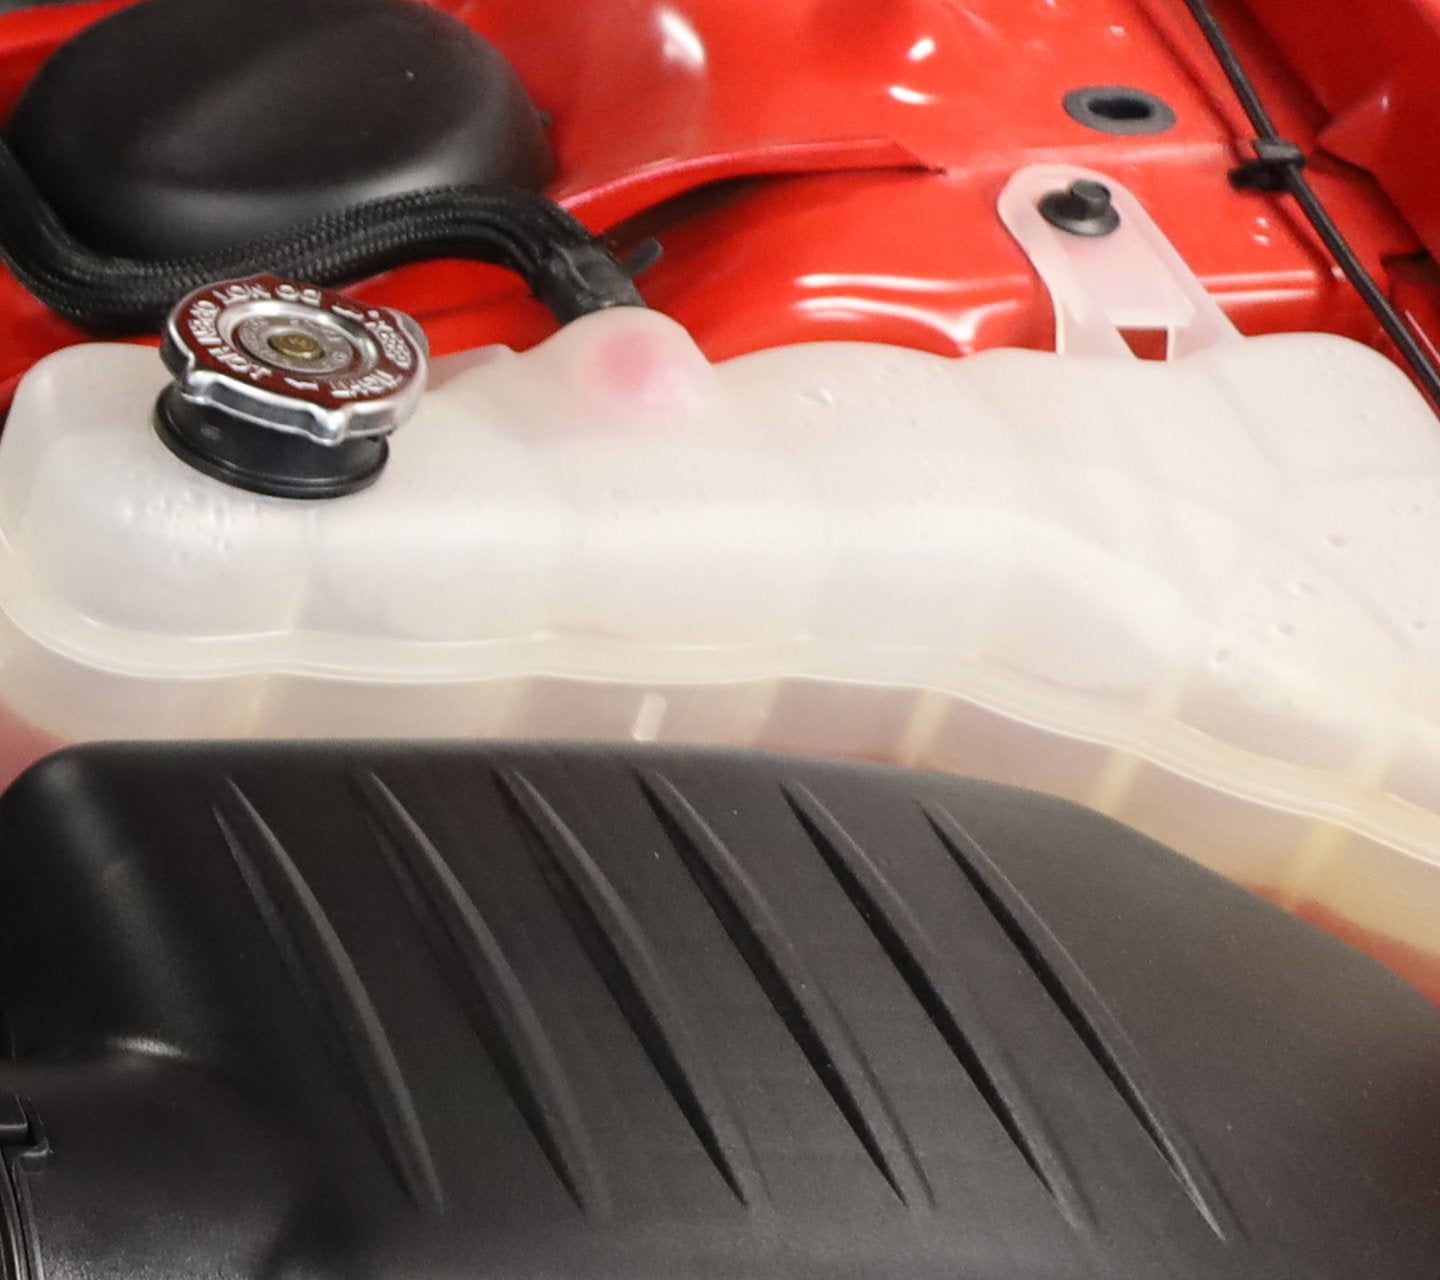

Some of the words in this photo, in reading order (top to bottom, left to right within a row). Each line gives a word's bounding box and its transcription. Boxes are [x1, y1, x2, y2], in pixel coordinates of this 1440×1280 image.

[212, 282, 272, 306] NOT
[274, 283, 322, 308] DO
[188, 299, 223, 346] OPEN
[207, 345, 272, 380] HOT
